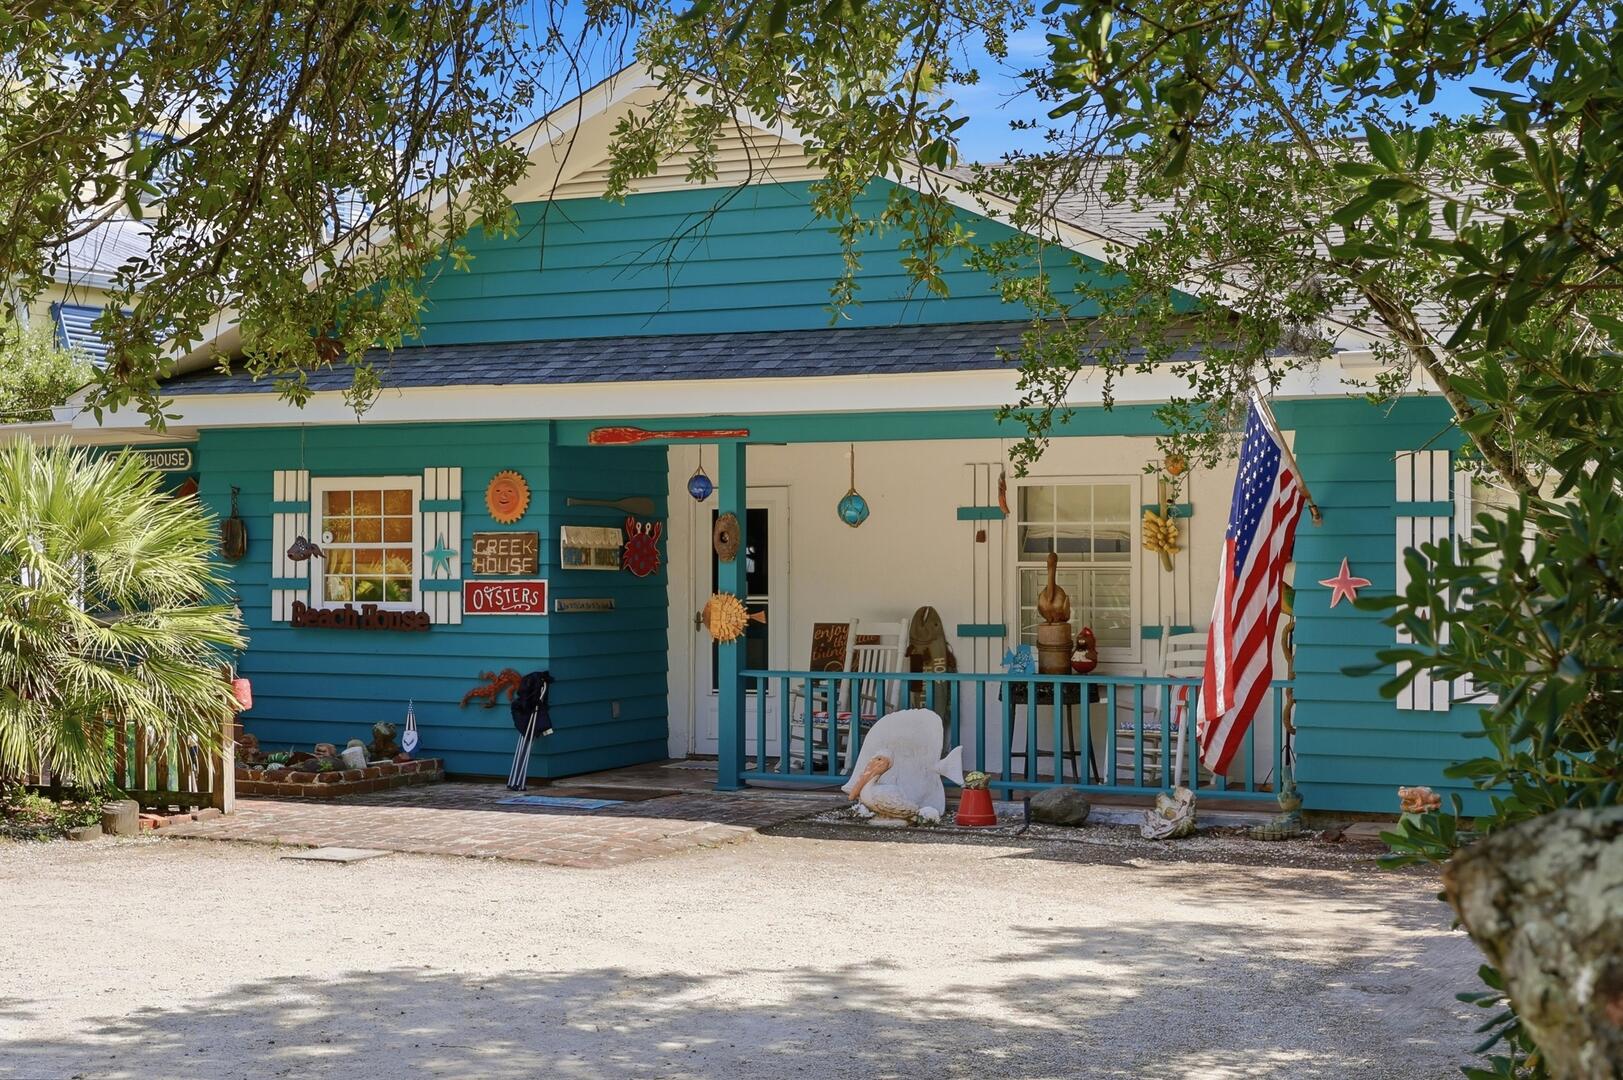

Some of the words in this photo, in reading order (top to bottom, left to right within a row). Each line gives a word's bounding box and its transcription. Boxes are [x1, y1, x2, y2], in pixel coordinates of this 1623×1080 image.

[474, 539, 533, 556] CREEK
[473, 557, 533, 573] HOUSE
[473, 586, 540, 610] OYSTERS
[291, 600, 360, 628] Beach
[360, 603, 431, 631] House
